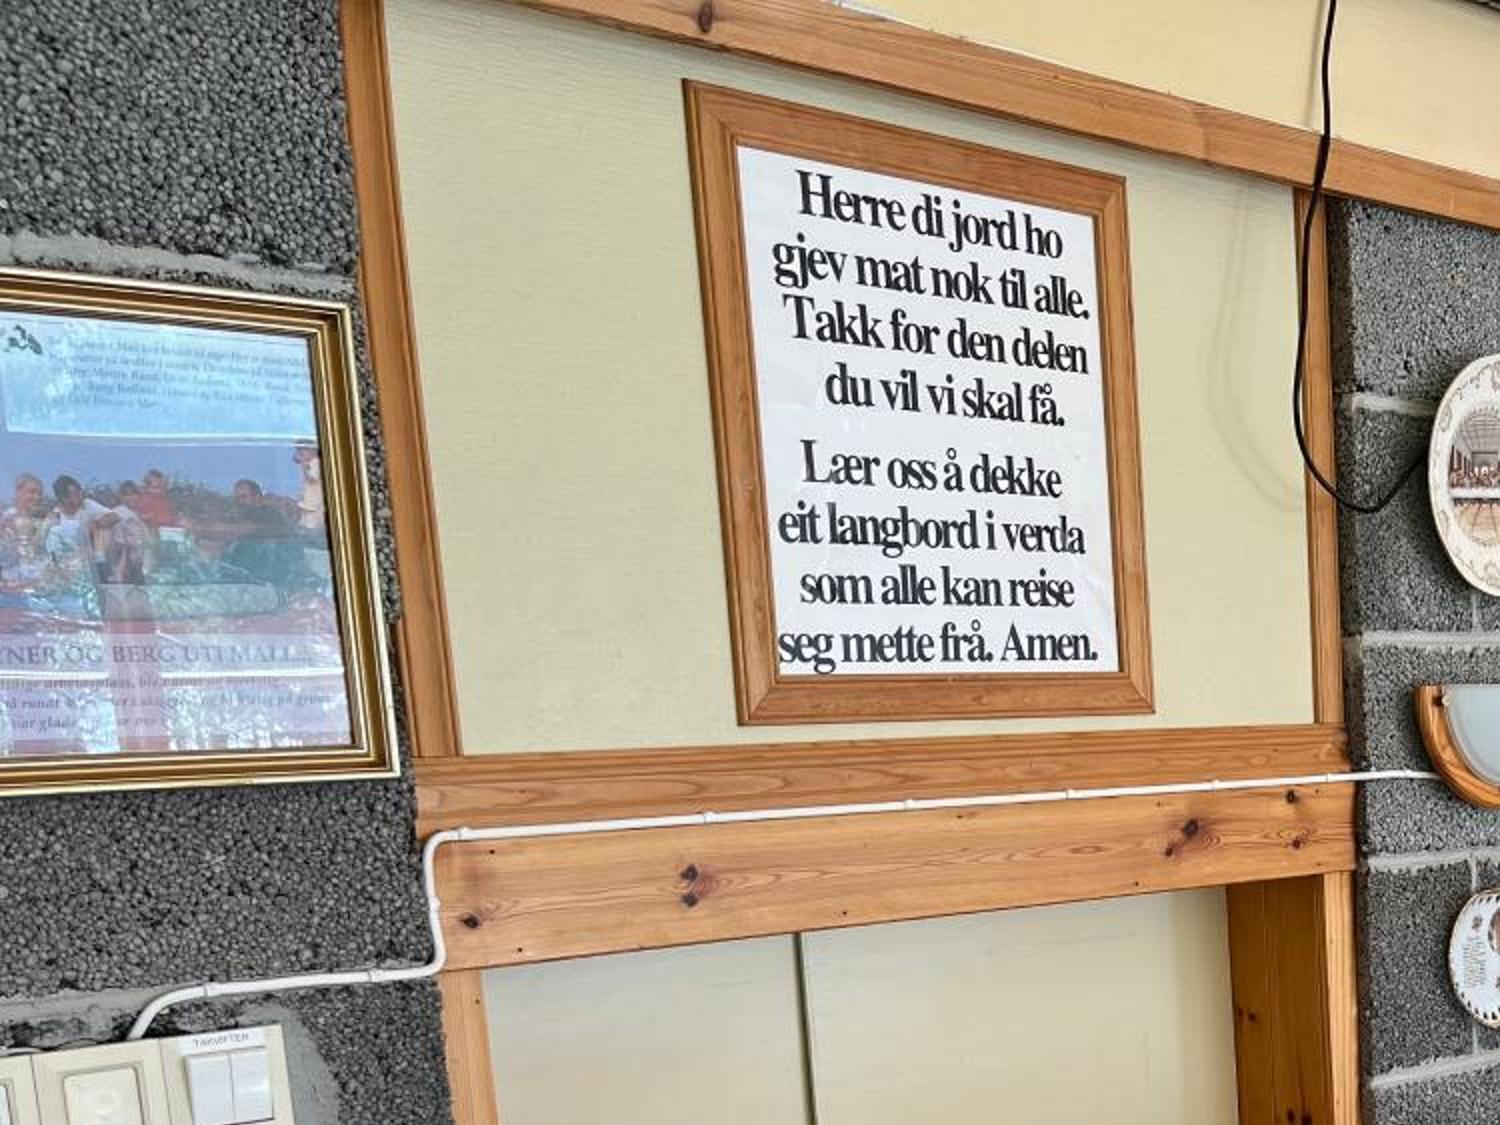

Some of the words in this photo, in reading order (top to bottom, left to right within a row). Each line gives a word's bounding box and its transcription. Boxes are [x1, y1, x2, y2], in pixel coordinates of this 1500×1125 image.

[796, 170, 906, 231] Herre
[912, 194, 945, 238] di
[949, 199, 1019, 252] jord
[1024, 214, 1062, 258] ho
[773, 233, 847, 289] gjev
[854, 256, 926, 294] mat
[930, 262, 994, 304] nok
[999, 268, 1029, 310] til
[1034, 275, 1089, 320] alle.
[783, 294, 885, 348] Takk
[890, 309, 940, 354] for
[947, 318, 1006, 363] den
[1012, 327, 1088, 374] delen
[826, 362, 875, 407] du
[880, 369, 920, 412] vil
[926, 374, 956, 415] vi
[962, 378, 1025, 423] skal
[1029, 383, 1065, 426] få.
[800, 440, 880, 486] Lær
[888, 458, 937, 490] oss
[944, 448, 965, 492] å
[970, 453, 1062, 498] dekke
[779, 500, 822, 544] eit
[828, 502, 980, 558] langbord
[986, 510, 996, 550] i
[1002, 515, 1086, 555] verda
[801, 574, 874, 604] som
[881, 565, 936, 605] alle
[941, 566, 1004, 606] kan
[1008, 569, 1074, 607] reise
[112, 645, 176, 664] BERG
[778, 634, 836, 677] seg
[841, 626, 934, 663] mette
[940, 619, 993, 662] frå.
[1001, 624, 1098, 661] Amen.
